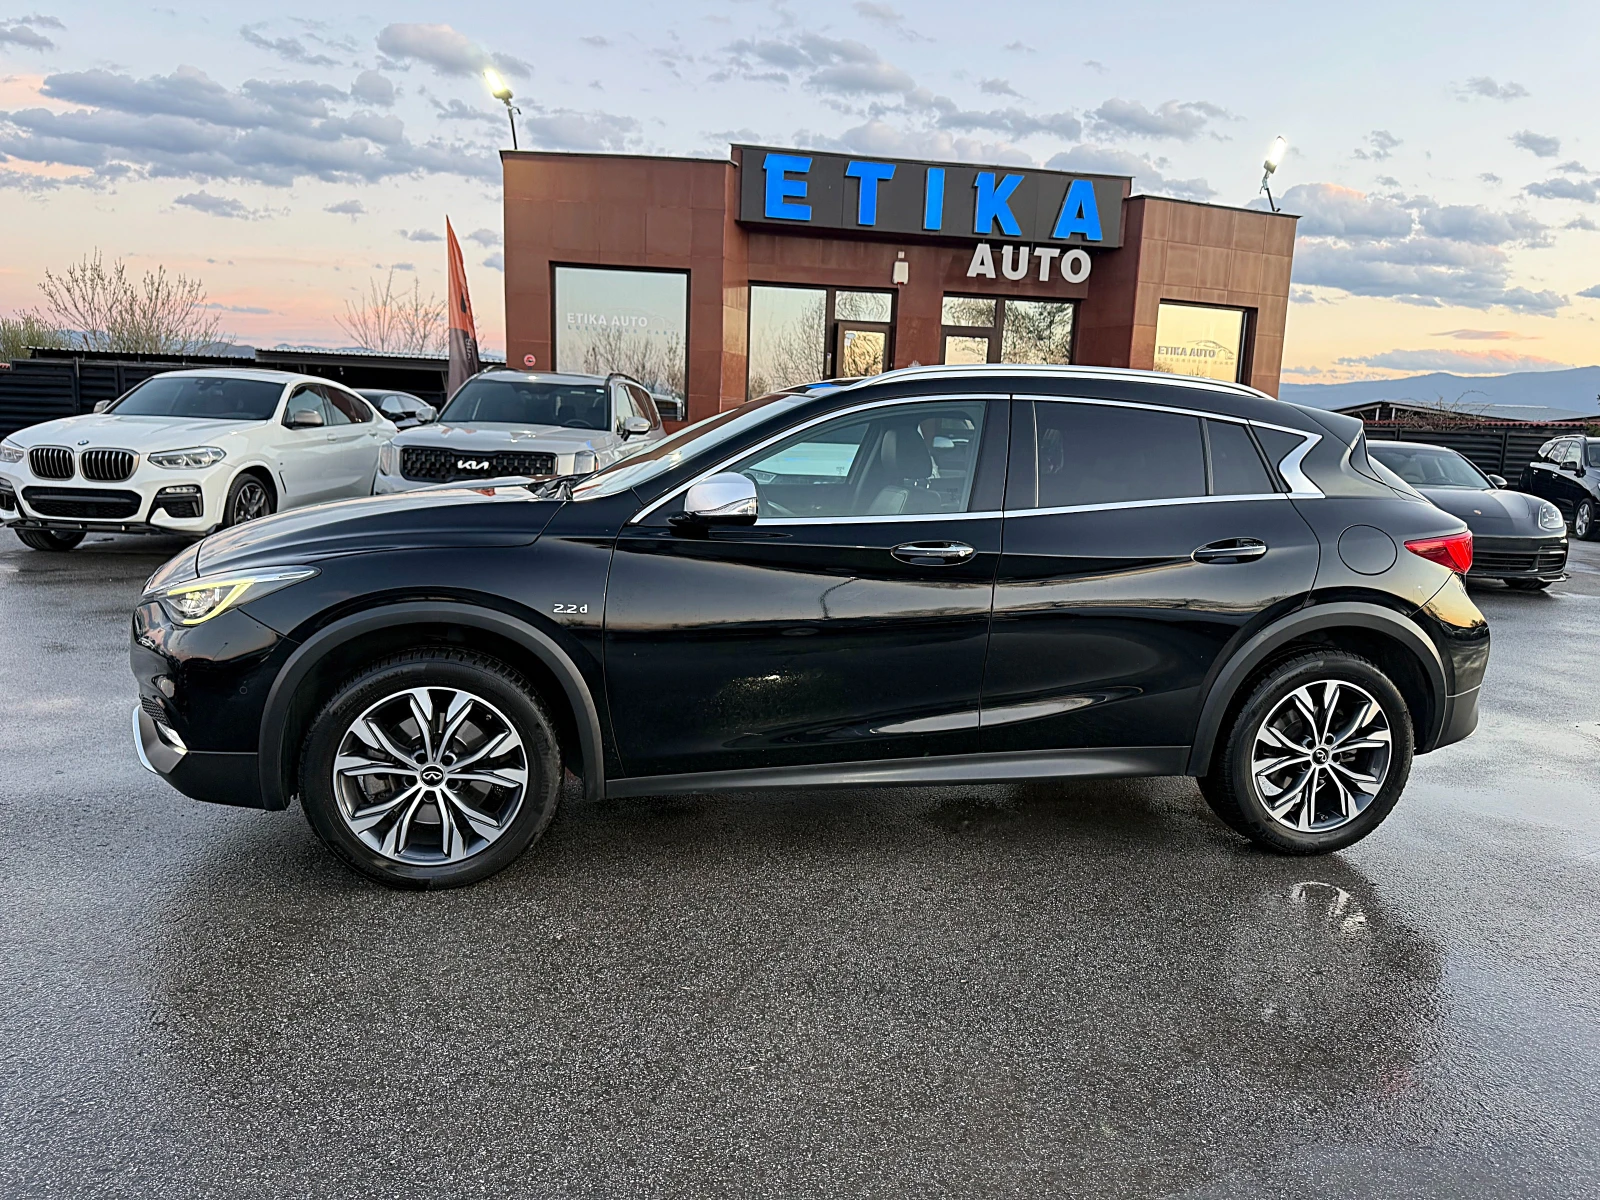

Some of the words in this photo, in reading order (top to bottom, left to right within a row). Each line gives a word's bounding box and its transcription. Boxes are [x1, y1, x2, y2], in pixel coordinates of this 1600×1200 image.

[763, 153, 1103, 240] ETIKA
[966, 243, 1092, 283] AUTO
[567, 312, 607, 325] ETIKA
[611, 315, 648, 327] AUTO
[1158, 346, 1187, 356] ETIKA
[1189, 348, 1216, 358] AUTO
